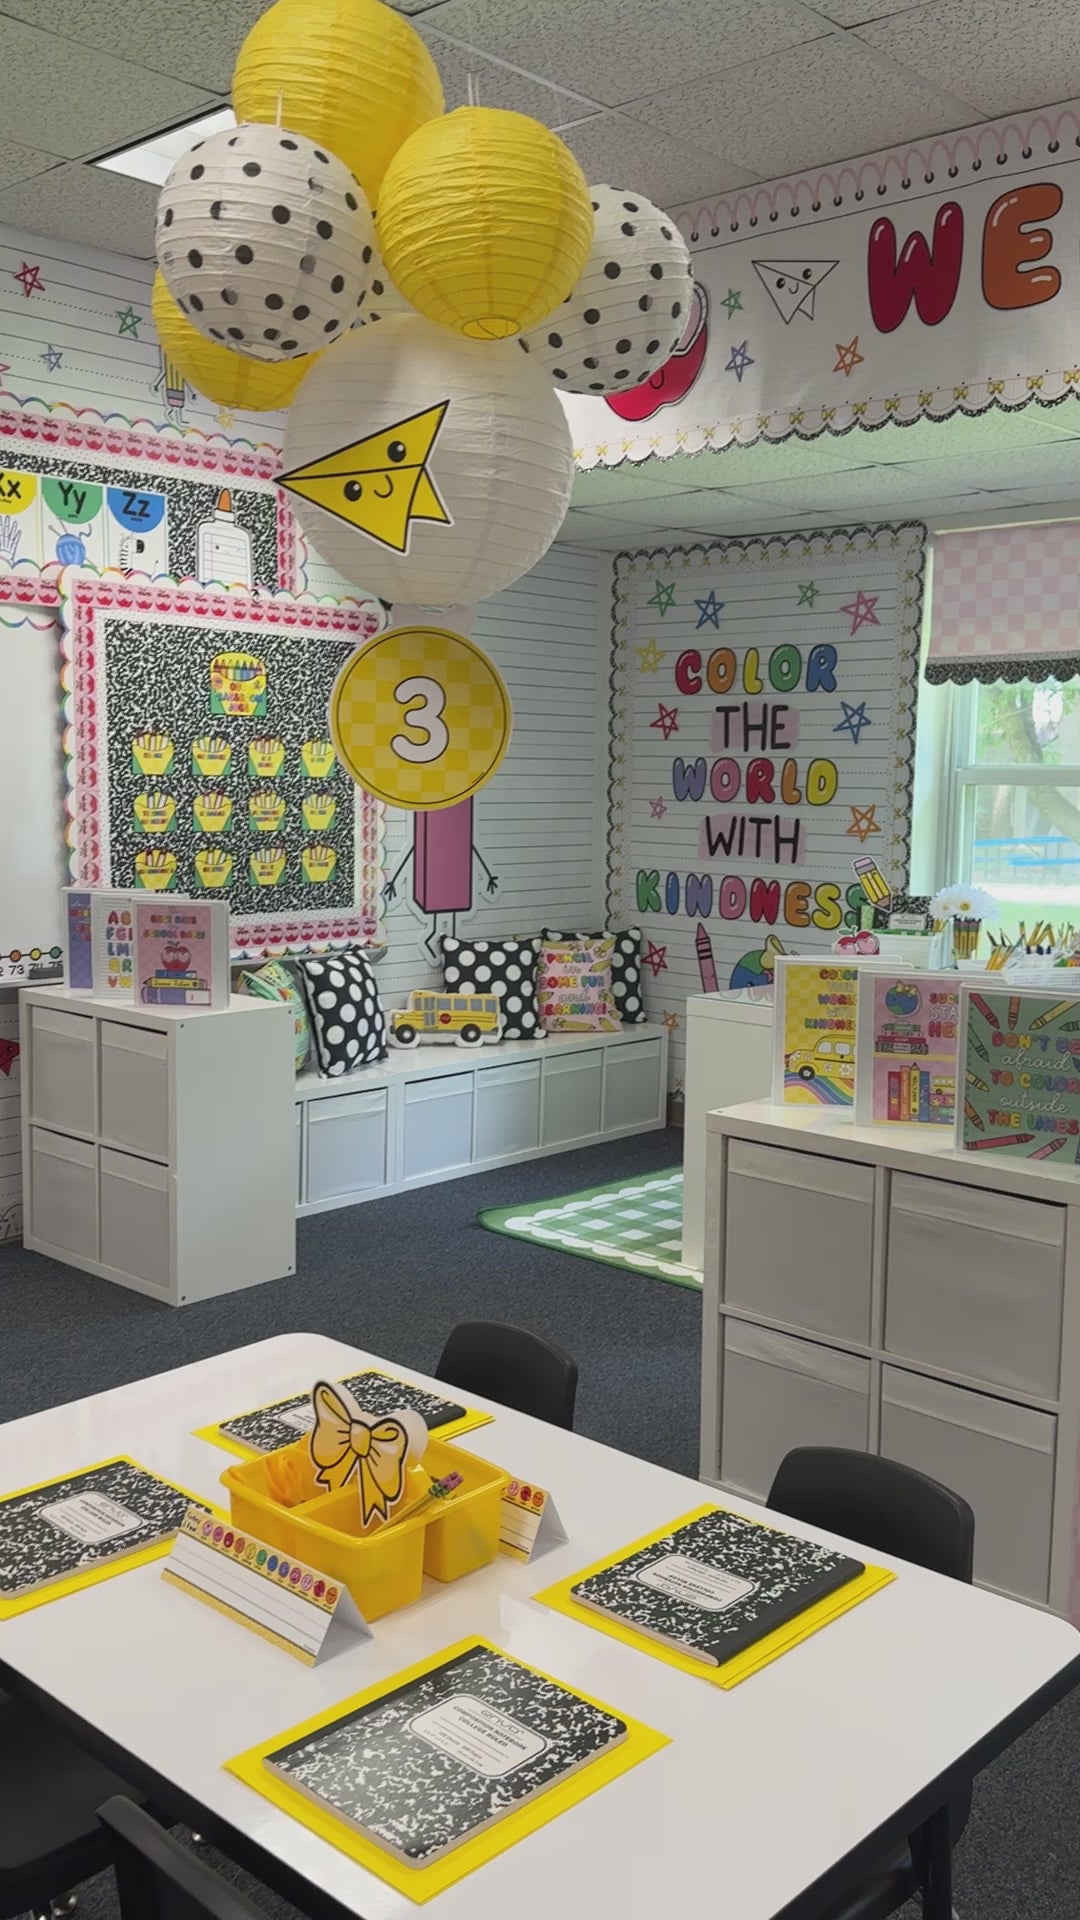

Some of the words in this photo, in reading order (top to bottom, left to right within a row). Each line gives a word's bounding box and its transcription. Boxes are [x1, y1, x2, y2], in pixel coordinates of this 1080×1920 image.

[867, 182, 1064, 334] WE
[58, 481, 86, 514] Yy
[122, 491, 150, 518] Zz
[674, 643, 838, 695] COLOR
[390, 675, 450, 764] 3
[715, 702, 791, 752] THE
[672, 756, 838, 806] WORLD
[705, 815, 800, 864] WITH
[635, 868, 868, 931] KINDNESS
[8, 964, 25, 976] 73
[538, 976, 577, 989] SOME
[581, 975, 605, 988] FUN
[817, 993, 857, 1006] WORL
[804, 1017, 857, 1031] KINDNE
[991, 1031, 1050, 1052] DON'T
[1056, 1037, 1080, 1055] BE
[1001, 1048, 1072, 1071] afraid
[990, 1069, 1014, 1086] TO
[1019, 1072, 1080, 1095] COLOR
[1000, 1090, 1068, 1113] outside
[987, 1109, 1021, 1129] THE
[1026, 1113, 1079, 1135] LINES
[453, 1705, 494, 1731] COMPOSITION
[493, 1727, 527, 1751] NOTEBOOK
[458, 1715, 487, 1735] COLLEGE
[485, 1731, 509, 1748] RULED
